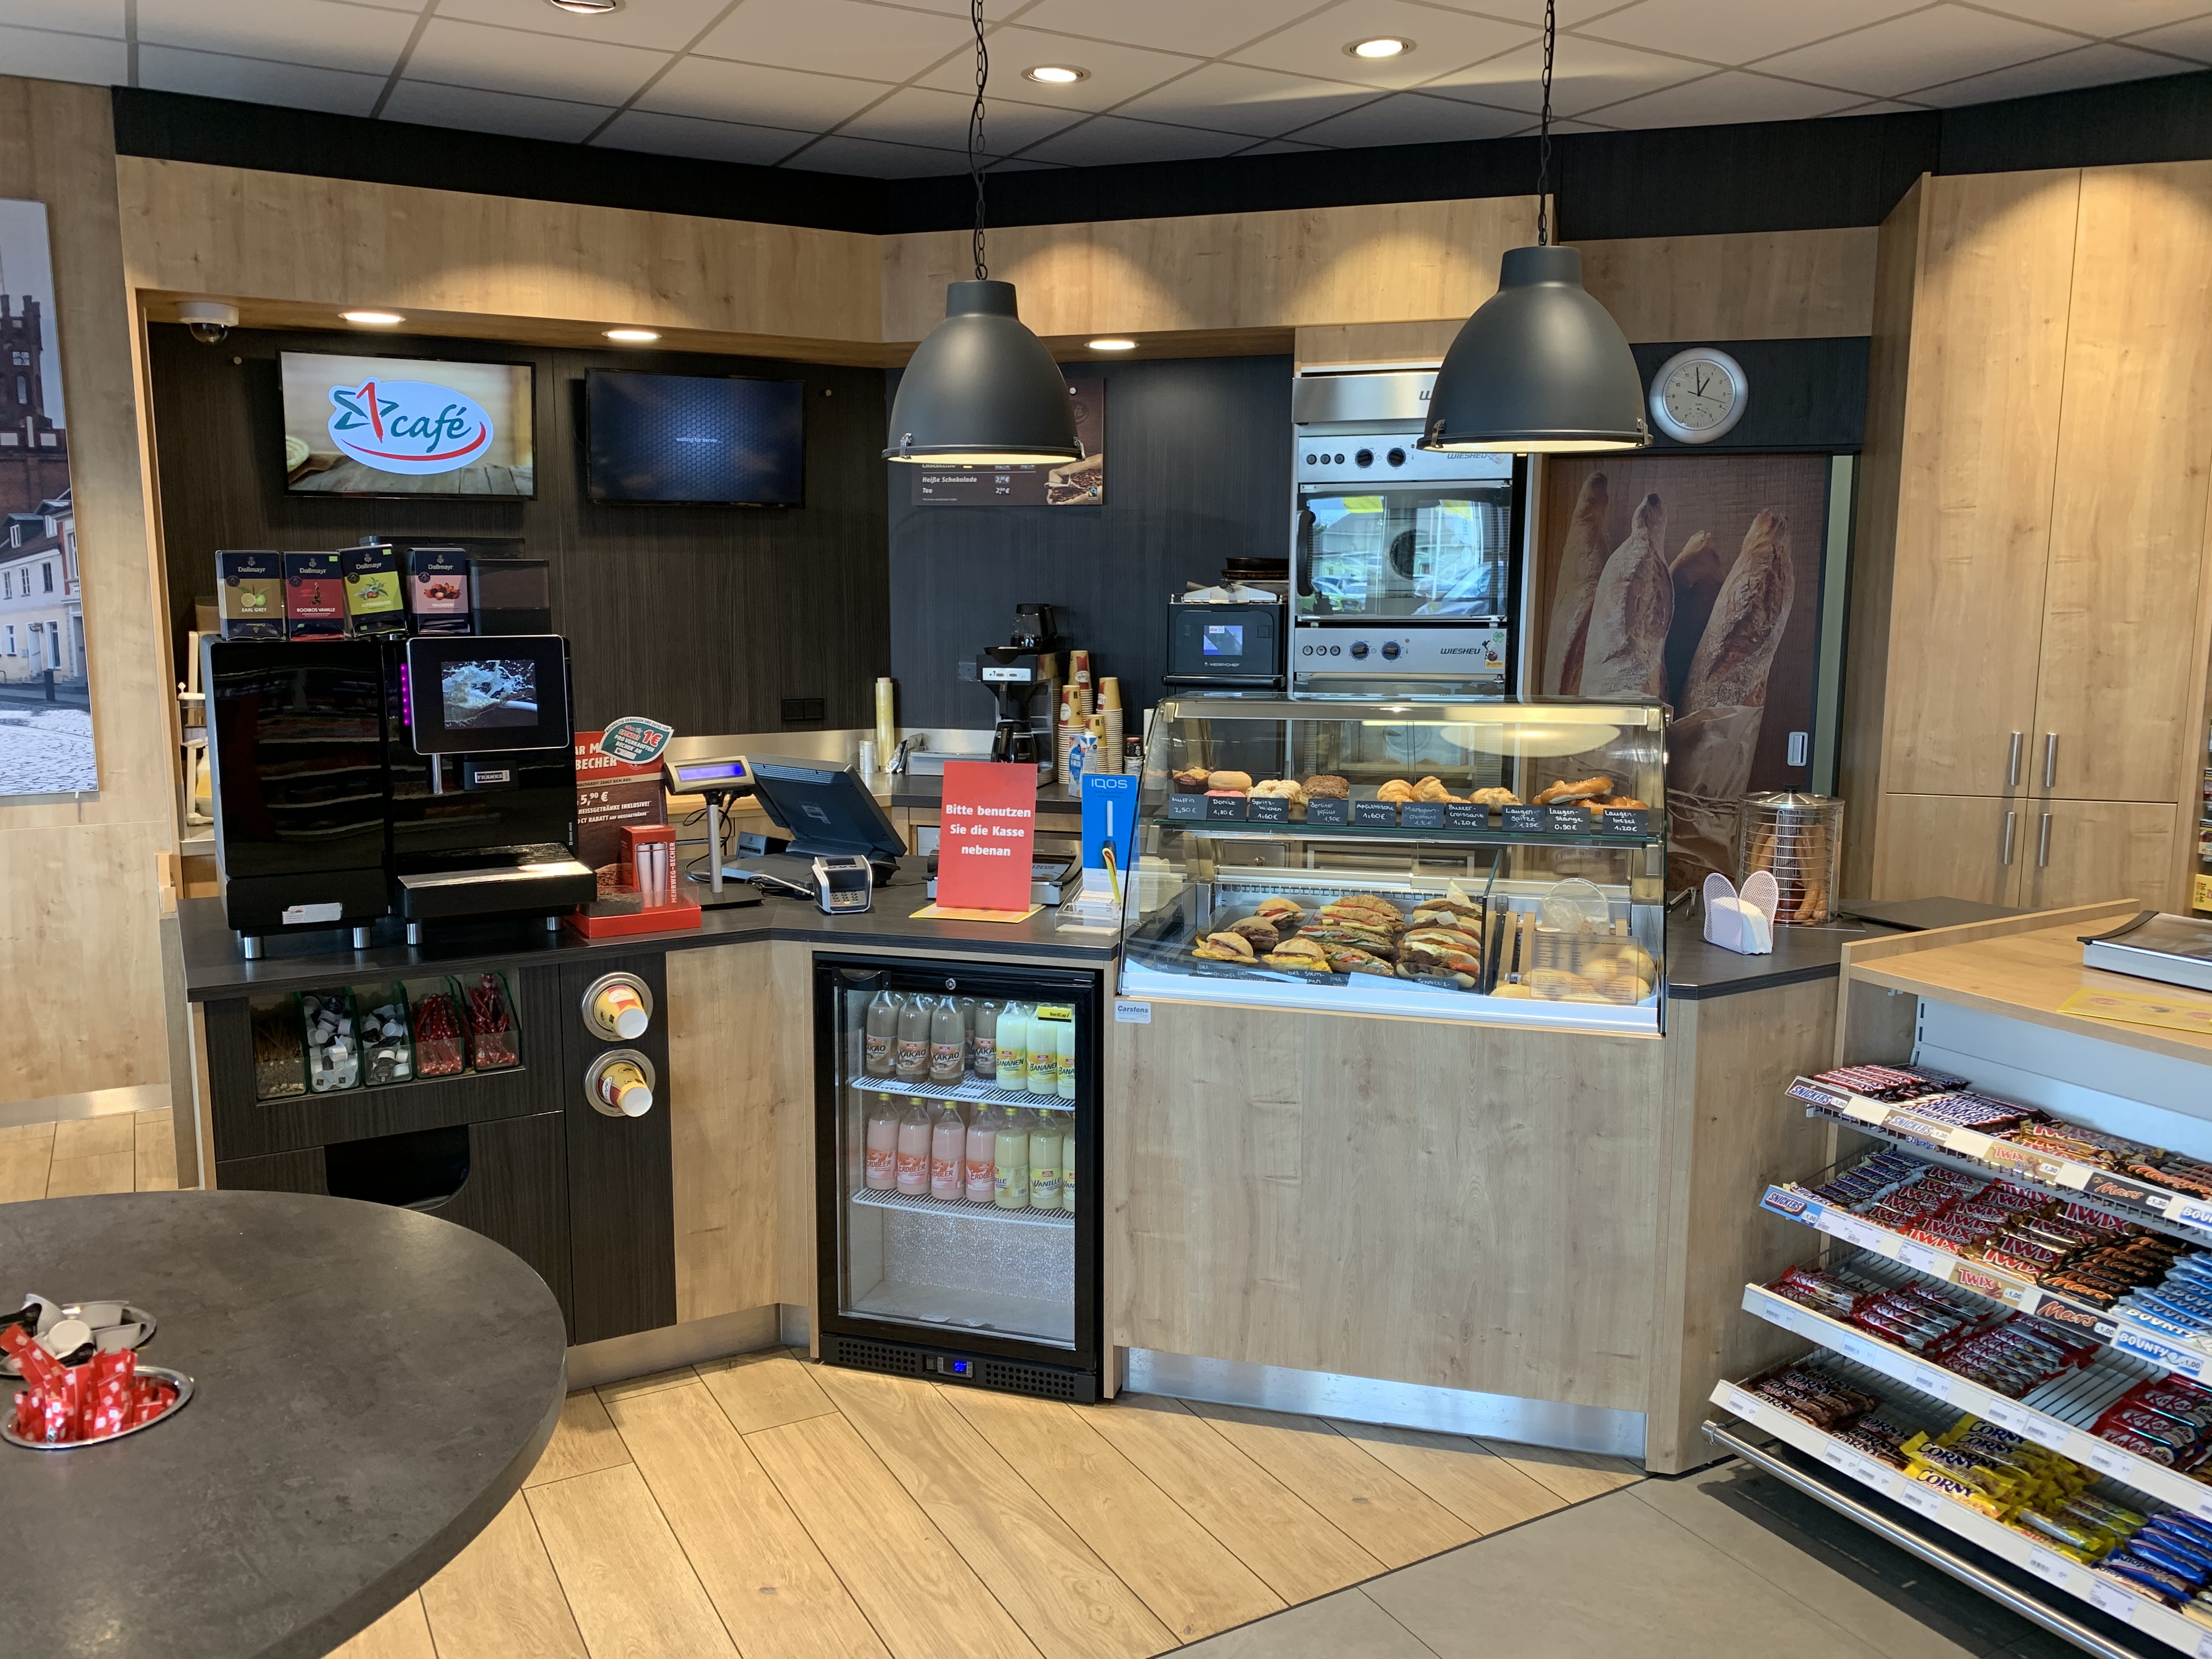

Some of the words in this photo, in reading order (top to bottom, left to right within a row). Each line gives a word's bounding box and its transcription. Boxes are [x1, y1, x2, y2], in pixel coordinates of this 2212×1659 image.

[391, 404, 472, 453] café
[355, 562, 382, 570] Dallmayr
[614, 734, 625, 743] PRO
[625, 737, 656, 753] VERKAUFTEN
[618, 729, 641, 741] SPENDET
[1091, 778, 1128, 789] IQOS
[1172, 795, 1195, 804] Muffin
[578, 803, 620, 815] HEISSGETRÄNKE
[946, 804, 973, 816] Bitte
[977, 805, 1031, 818] benutzen
[1549, 807, 1578, 816] Laugen-
[588, 815, 609, 823] RABATT
[950, 823, 967, 835] Sie
[970, 824, 989, 836] die
[992, 826, 1025, 838] Kasse
[961, 845, 1011, 856] nebenan
[1118, 1005, 1149, 1013] Carstens
[899, 1049, 926, 1058] KAKAO
[933, 1051, 960, 1062] KAKAO
[975, 1046, 996, 1055] KAKA
[996, 1058, 1024, 1067] BANANEN
[1791, 1086, 1832, 1104] SNICKERS
[1893, 1117, 1932, 1135] SNICKERS
[1993, 1145, 2027, 1162] Twix
[899, 1164, 926, 1173] ERDBEER
[1928, 1167, 1975, 1184] TWIX
[1034, 1176, 1062, 1188] VANILLE
[2095, 1182, 2145, 1200] Mars
[1768, 1193, 1803, 1210] SNICKERS
[2066, 1202, 2131, 1235] TWIX
[2182, 1207, 2212, 1223] BOU
[1922, 1217, 1973, 1241] TWIX
[1910, 1228, 1959, 1252] TWIX
[2001, 1235, 2063, 1262] TWIX
[1983, 1249, 2043, 1277] TWIX
[1958, 1267, 1994, 1290] Twix
[2044, 1276, 2113, 1300] Mars
[2036, 1301, 2098, 1327] Mars
[2126, 1308, 2200, 1339] BOUNTY
[2119, 1333, 2169, 1357] BOUNTY
[1763, 1385, 1784, 1397] BIG
[1783, 1372, 1837, 1395] CORNY
[1785, 1379, 1807, 1391] BIG
[1968, 1420, 2028, 1444] CORNY
[1956, 1434, 2016, 1454] CORNY
[1918, 1441, 1977, 1470] CORNY
[1916, 1469, 1975, 1498] CORNY
